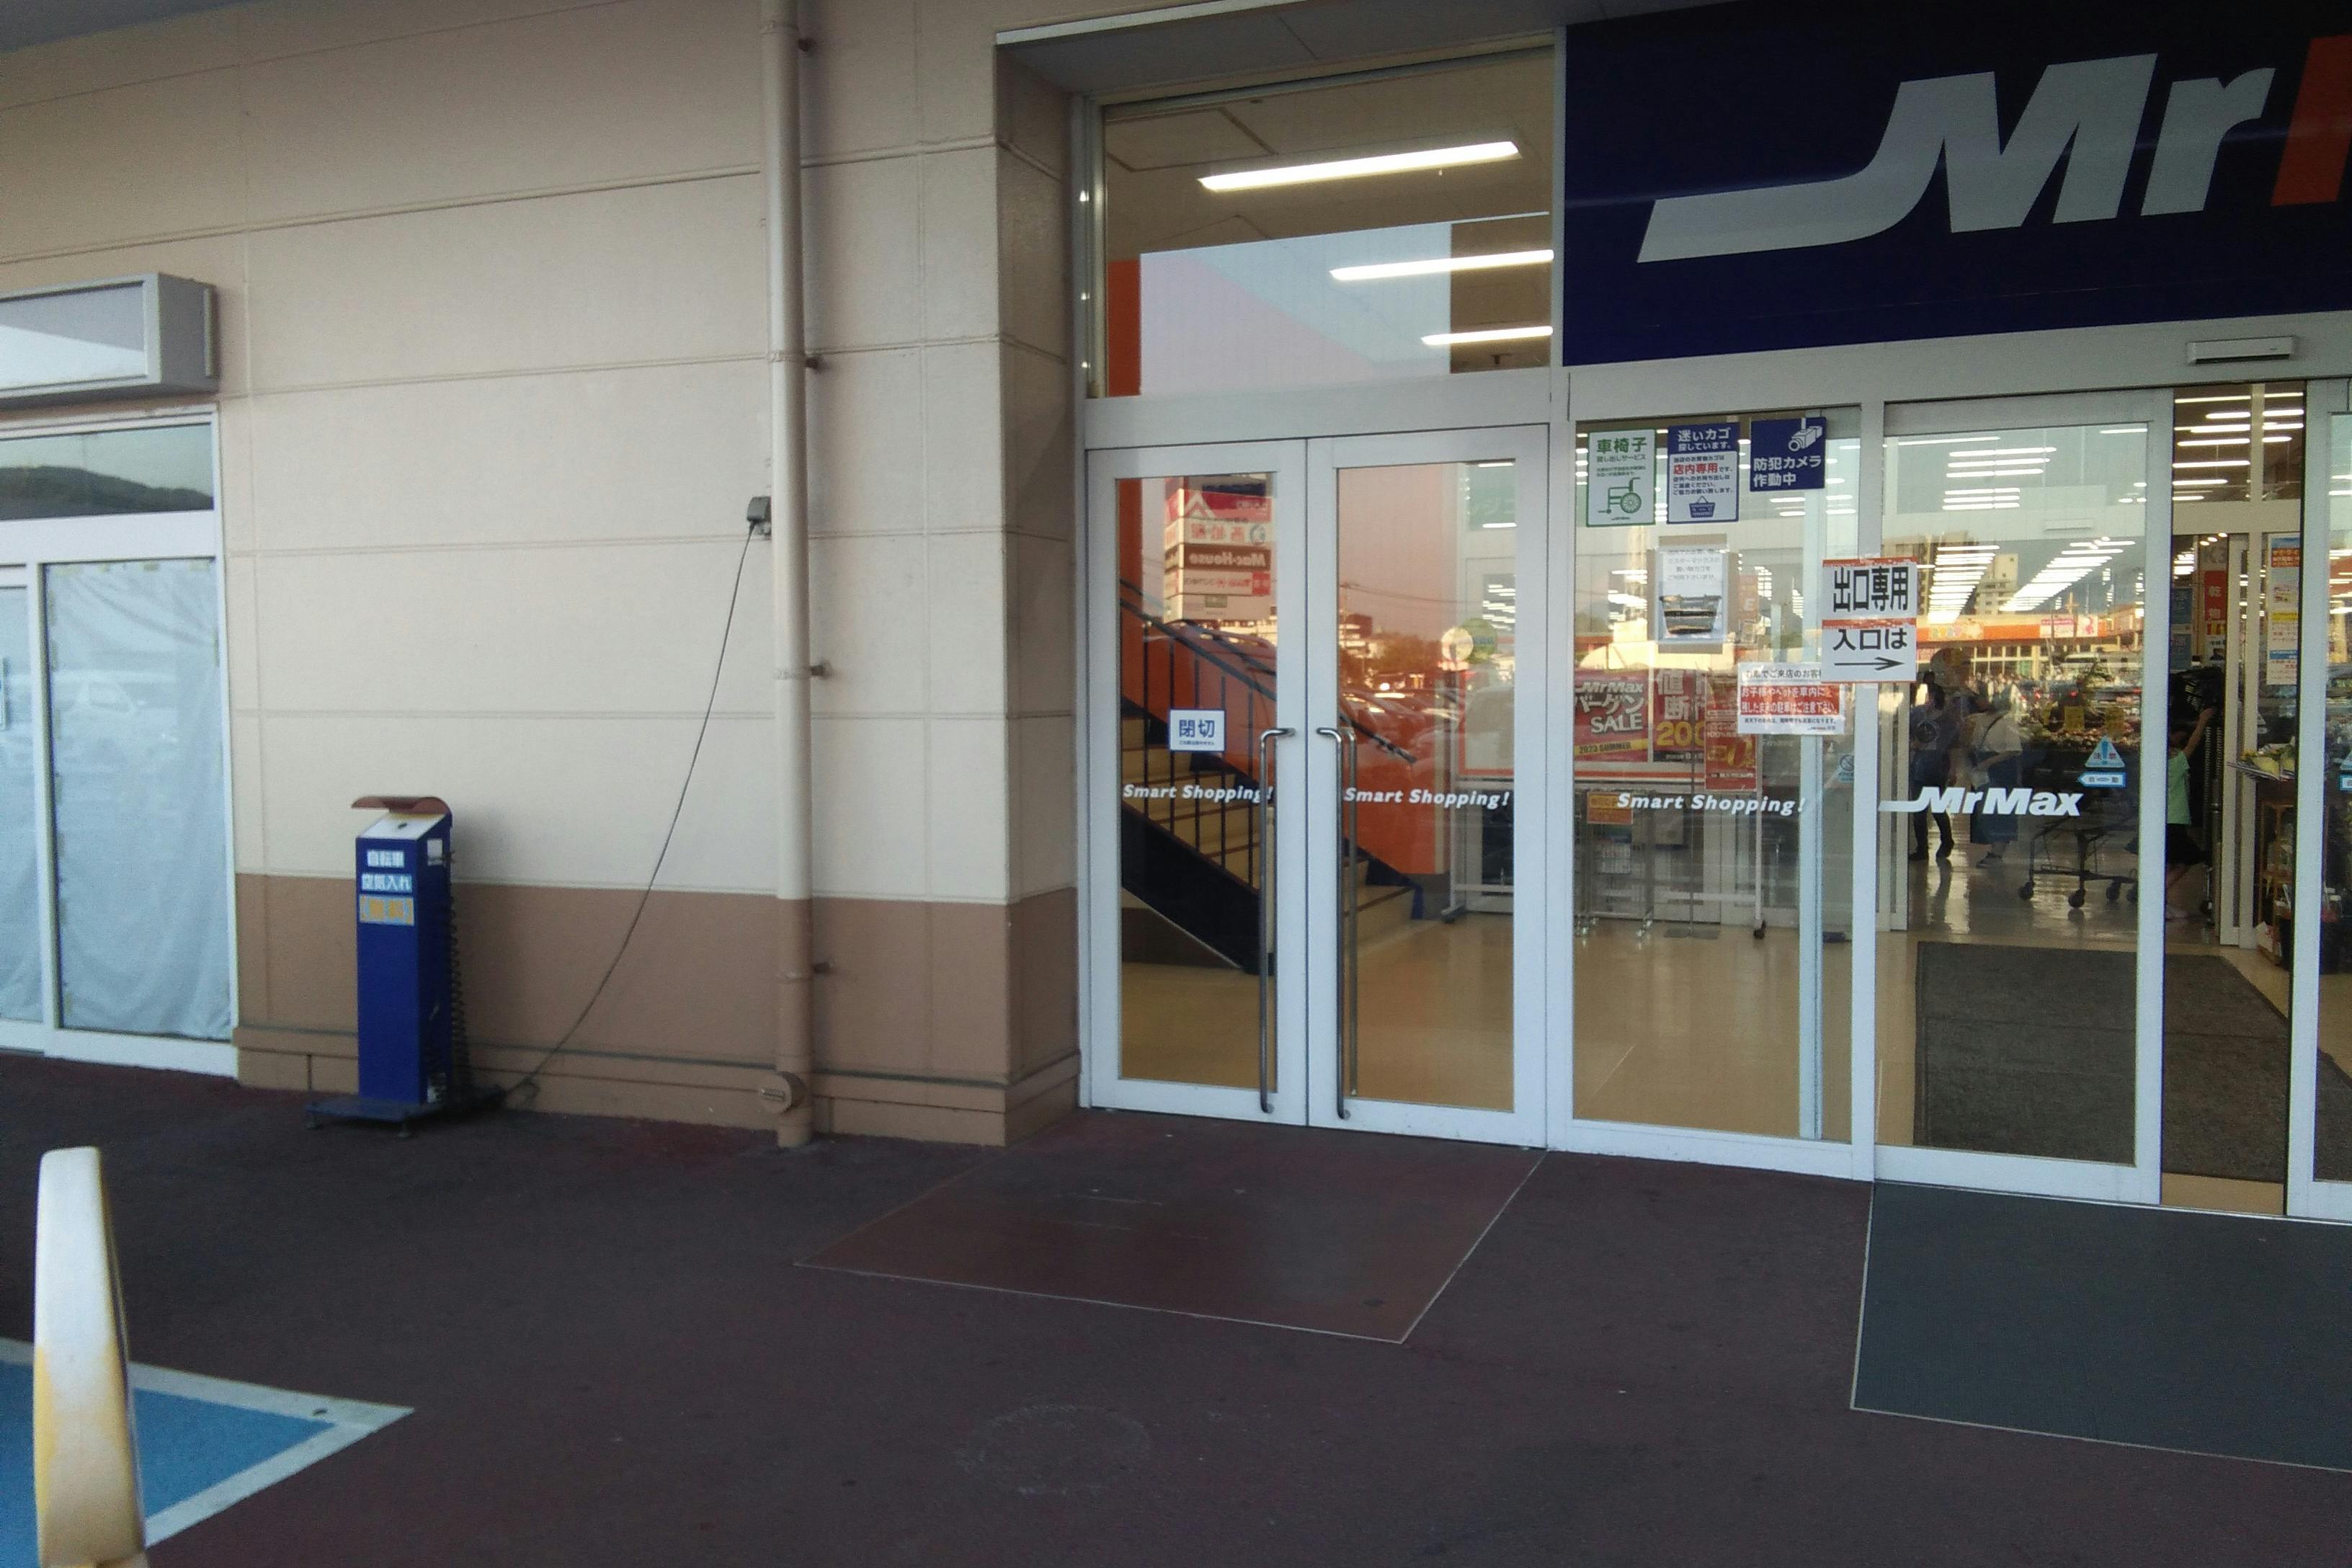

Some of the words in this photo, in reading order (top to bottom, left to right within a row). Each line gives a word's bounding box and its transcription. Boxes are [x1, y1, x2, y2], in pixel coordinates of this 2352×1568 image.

[1597, 437, 1647, 453] 車椅子
[1678, 427, 1731, 442] 迷いカゴ
[1753, 455, 1822, 471] 防犯カメラ
[1753, 472, 1796, 487] 作動中
[1833, 566, 1909, 612] 出口専用
[1832, 628, 1907, 651] 入口は
[1574, 694, 1644, 715] バーゲン
[1179, 719, 1215, 738] 閉切
[1590, 713, 1644, 734] SALE
[1123, 784, 1177, 798] Smart
[1343, 788, 1403, 803] Smart
[1409, 788, 1510, 810] Shopping!
[1878, 786, 2083, 816] MrMax
[1617, 793, 1685, 809] Smart
[1691, 794, 1806, 816] Shopping!
